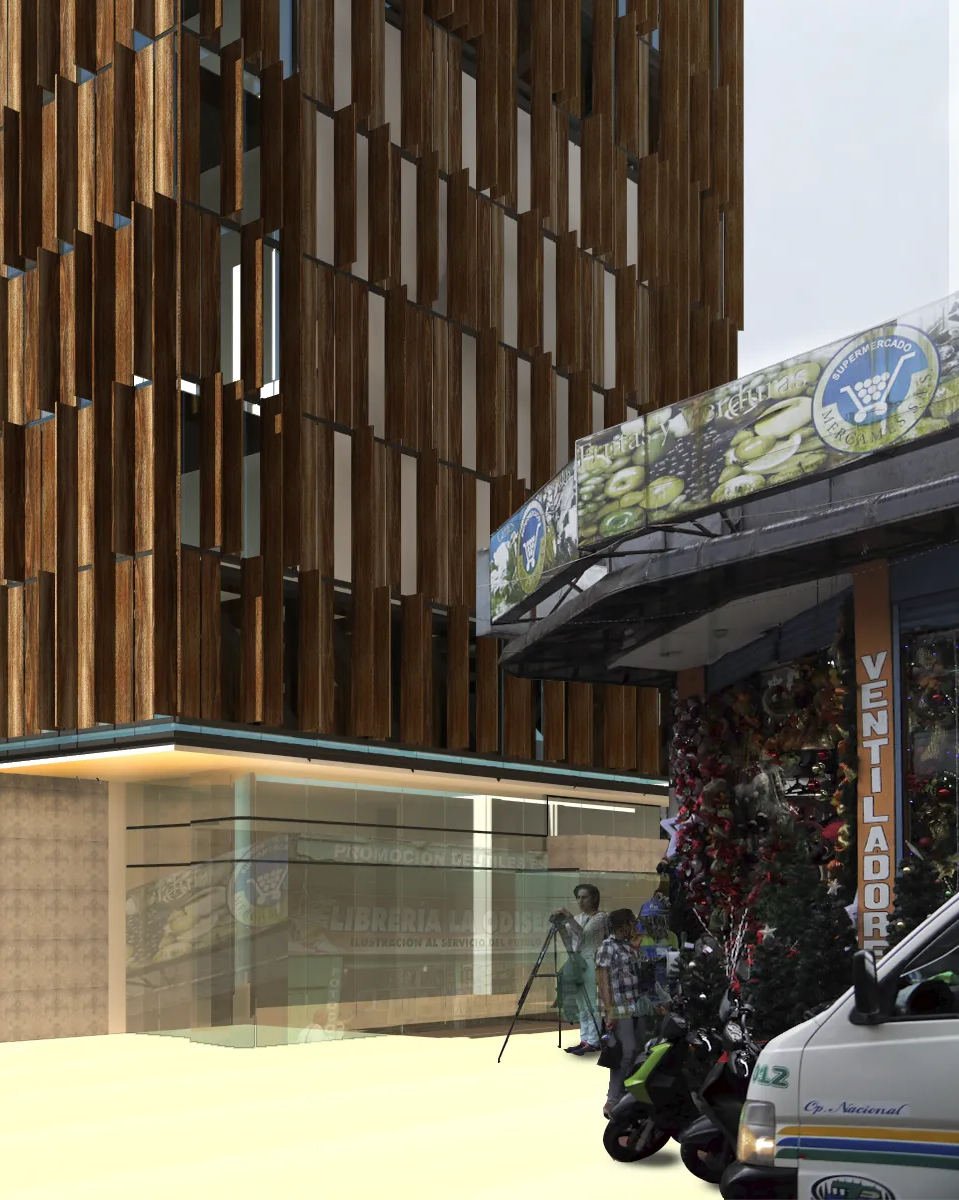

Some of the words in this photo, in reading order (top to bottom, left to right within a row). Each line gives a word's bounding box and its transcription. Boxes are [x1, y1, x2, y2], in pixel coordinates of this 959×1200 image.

[832, 338, 912, 381] SUPERMERCADO
[578, 429, 651, 467] Frutas
[677, 368, 808, 433] Verduras
[329, 901, 442, 933] LIBRERÍA
[449, 907, 478, 934] LA
[425, 938, 438, 948] AL
[441, 938, 485, 948] SERVICIO
[828, 1100, 911, 1116] Nacional
